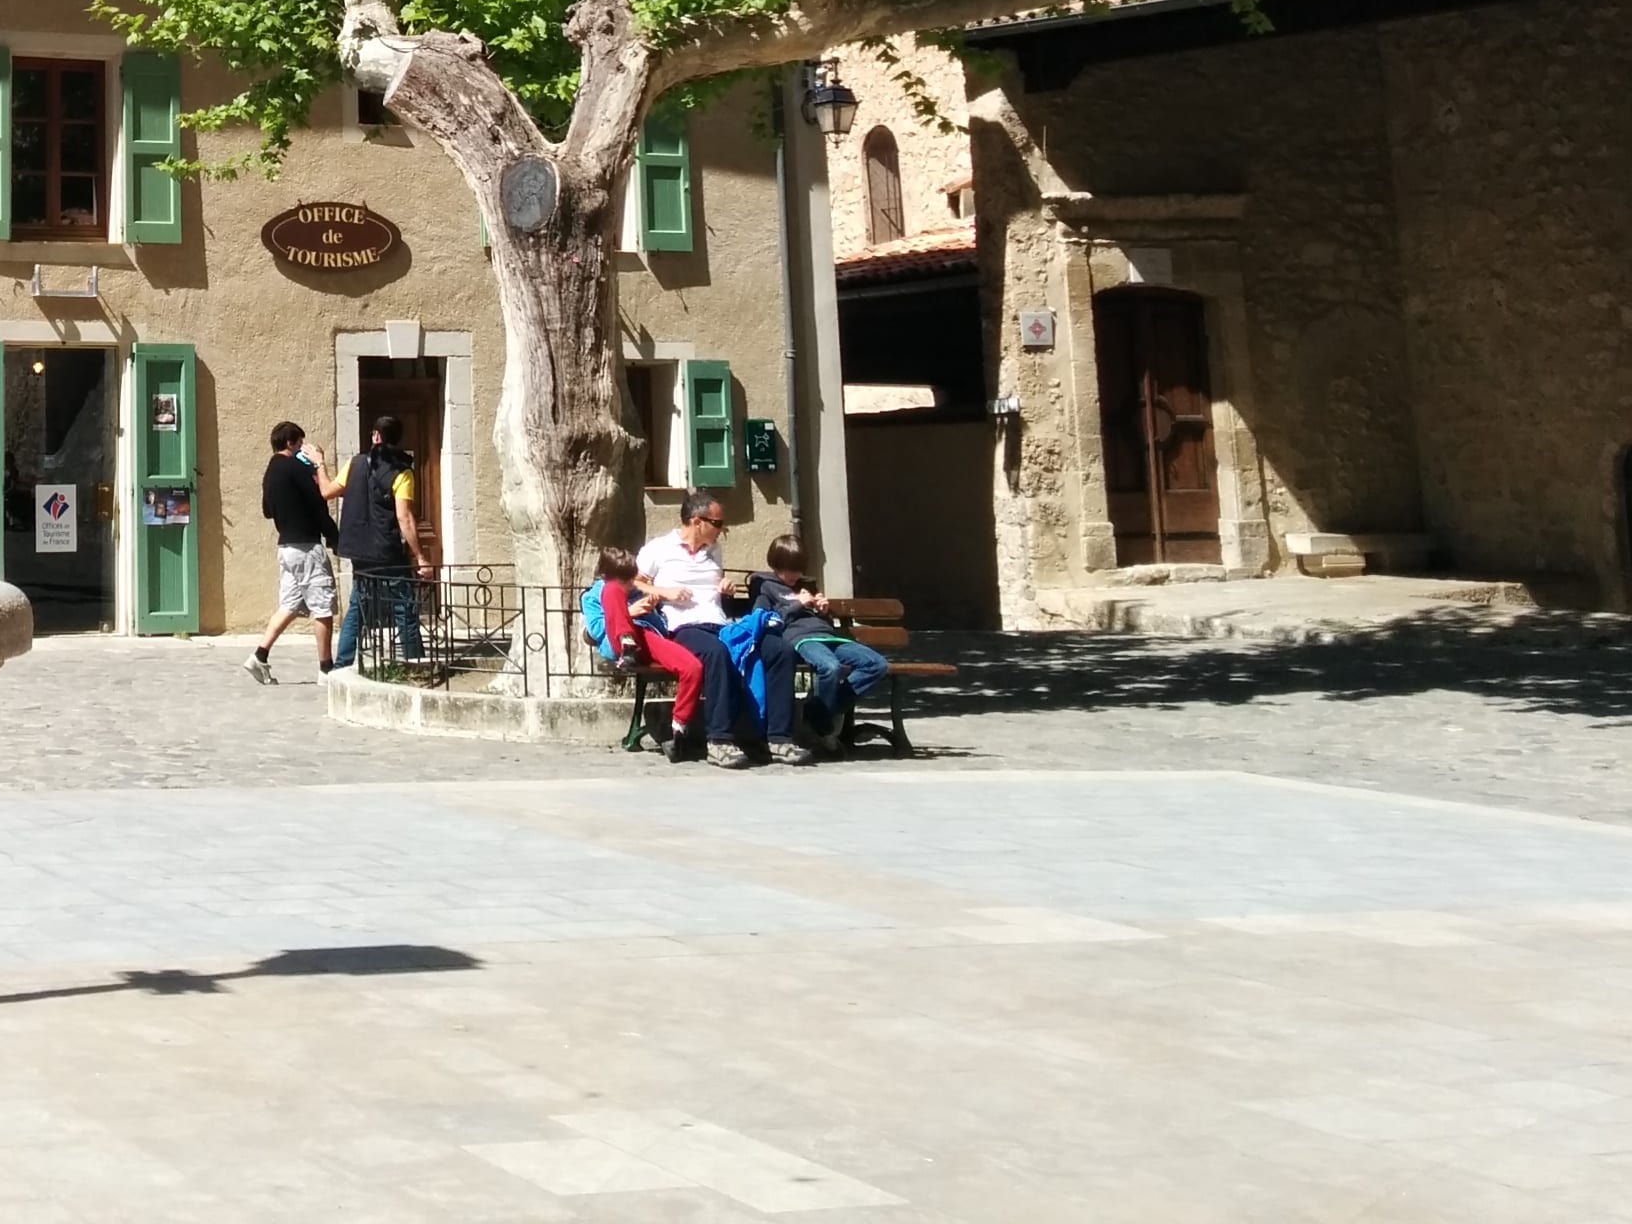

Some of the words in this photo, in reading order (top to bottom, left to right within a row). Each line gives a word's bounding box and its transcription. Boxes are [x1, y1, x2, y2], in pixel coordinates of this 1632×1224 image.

[298, 207, 366, 224] OFFICE
[322, 229, 344, 244] de
[286, 245, 380, 267] TOURISME
